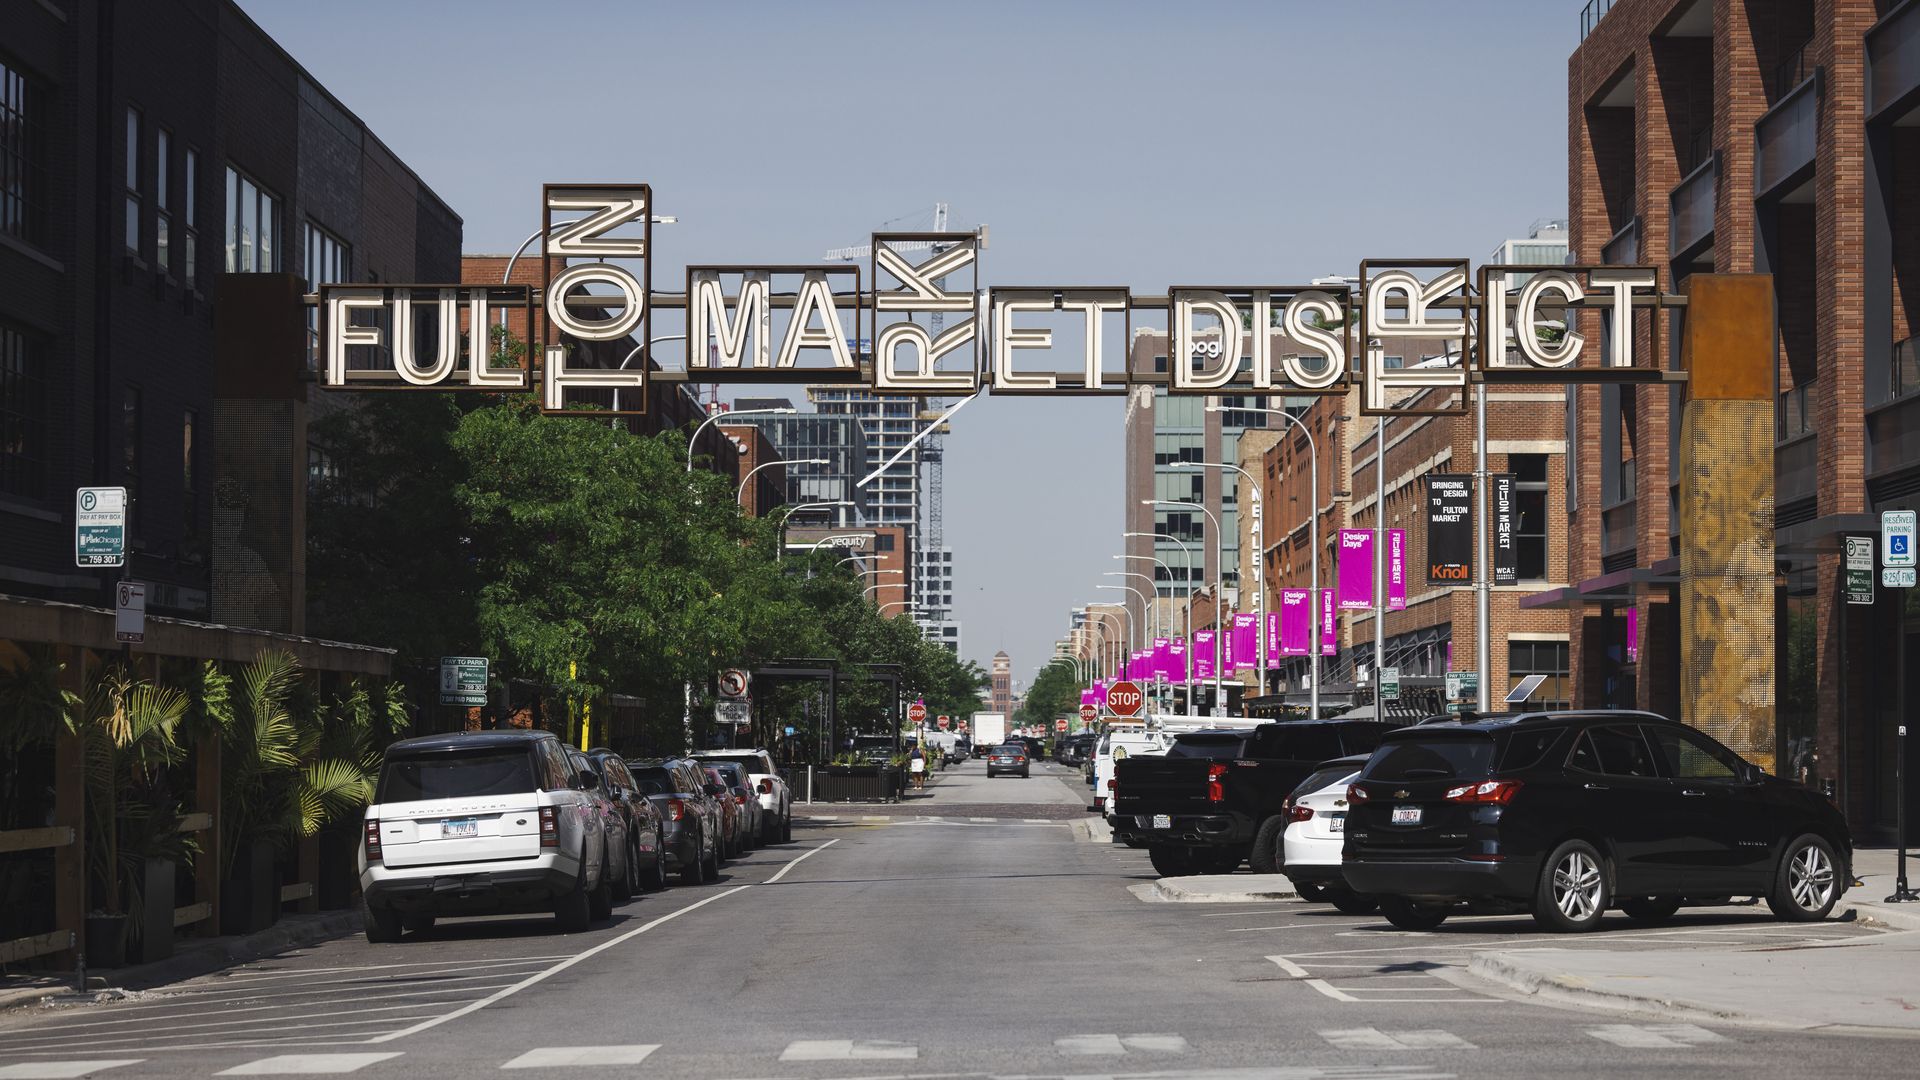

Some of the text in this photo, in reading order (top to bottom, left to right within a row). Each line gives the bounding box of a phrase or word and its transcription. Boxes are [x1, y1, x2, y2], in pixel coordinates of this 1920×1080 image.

[327, 190, 1656, 411] FULTON MARKET DISTRICT
[1431, 481, 1464, 490] BRINGING
[1443, 490, 1468, 498] DESIGN
[1432, 498, 1442, 506] TO
[1442, 506, 1468, 514] FULTON
[1498, 479, 1510, 549] FULTON MARKET
[1432, 514, 1461, 522] MARKET
[1884, 516, 1913, 524] RESERVED
[1886, 525, 1912, 533] PARKING
[1343, 532, 1370, 542] Design
[831, 536, 867, 549] vequity
[1343, 540, 1362, 549] Days
[89, 555, 102, 564] 759
[103, 555, 116, 563] 301
[1392, 533, 1401, 585] FULTON MARKET
[1431, 564, 1468, 579] Knoll
[1902, 572, 1914, 583] FINE
[1284, 591, 1307, 600] Design
[1284, 597, 1301, 606] Days
[1109, 692, 1140, 706] STOP
[719, 704, 738, 712] CLASS
[909, 709, 925, 717] STOP
[1080, 709, 1096, 717] STOP
